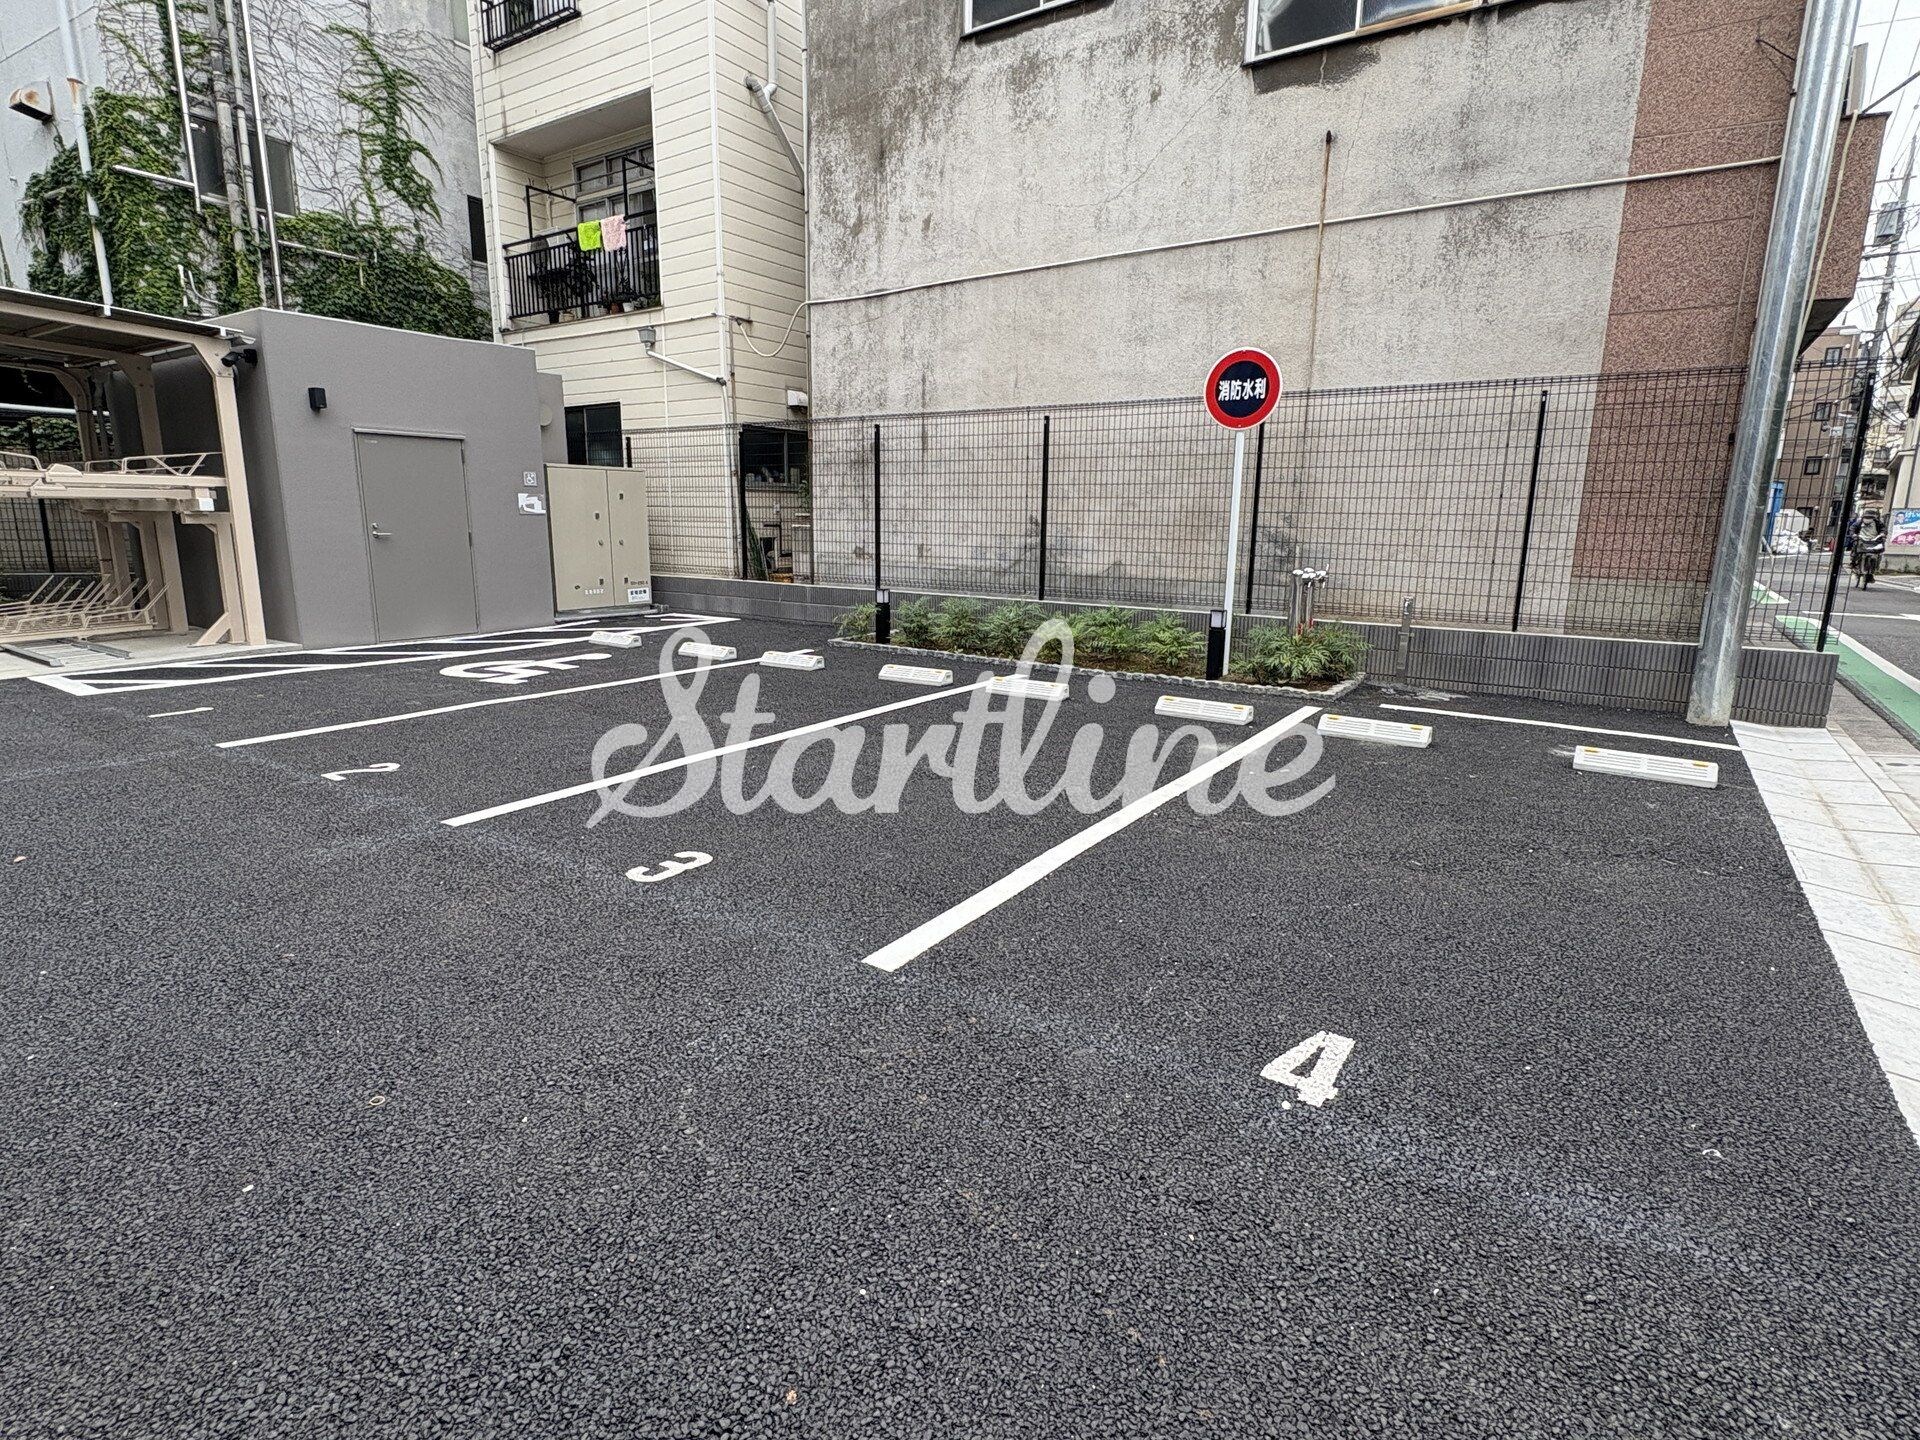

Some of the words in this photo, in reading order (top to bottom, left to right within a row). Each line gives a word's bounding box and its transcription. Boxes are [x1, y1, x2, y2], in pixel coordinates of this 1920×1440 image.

[1217, 377, 1267, 402] 消防水利
[320, 762, 401, 781] 2
[625, 850, 714, 883] 3
[1259, 1030, 1356, 1108] 4
